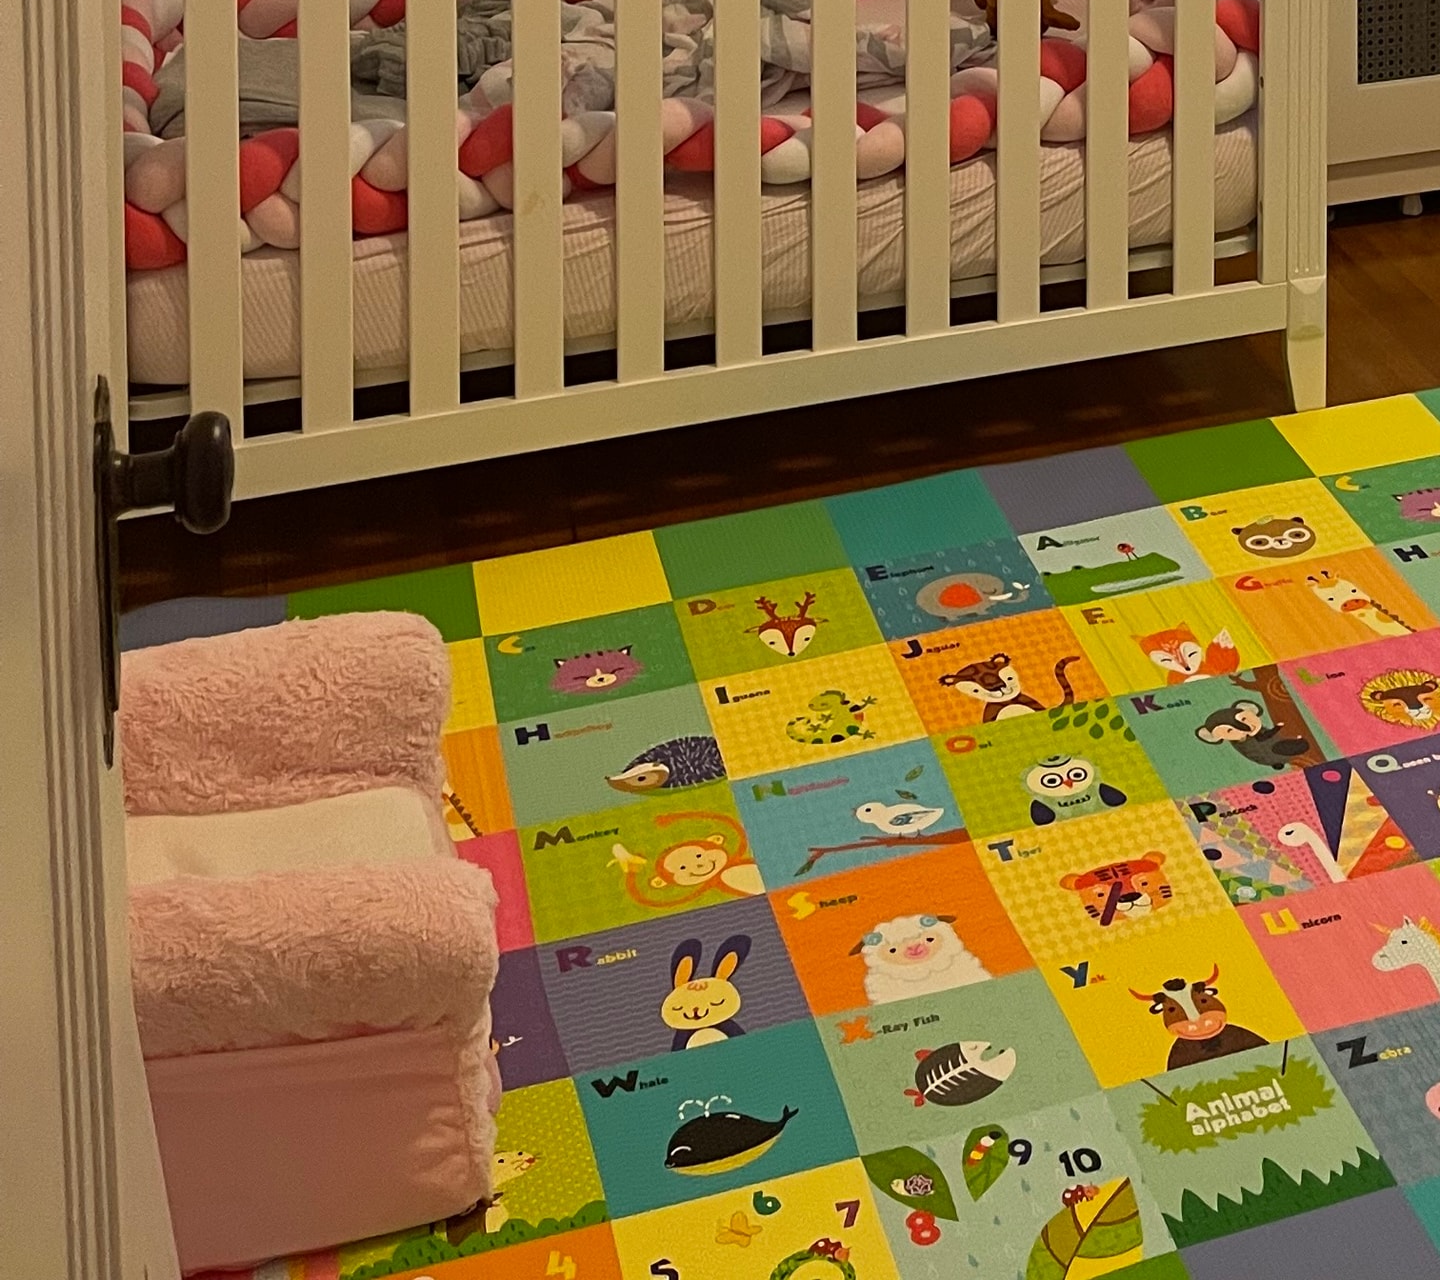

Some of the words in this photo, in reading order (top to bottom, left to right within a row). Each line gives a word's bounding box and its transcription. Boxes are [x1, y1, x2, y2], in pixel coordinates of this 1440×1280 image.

[533, 826, 619, 850] Monkey
[787, 891, 857, 919] Sheep
[1261, 907, 1341, 935] Unicorn
[556, 945, 636, 972] Rabbit
[836, 1016, 908, 1044] X-Ray
[912, 1013, 940, 1027] Fish
[1335, 1036, 1411, 1069] Zebra
[590, 1070, 668, 1098] Whale
[1185, 1077, 1283, 1122] Animal
[1191, 1096, 1291, 1136] alphabet
[1007, 1138, 1032, 1165] 9
[1058, 1147, 1102, 1177] 10
[753, 1190, 782, 1215] 6
[835, 1199, 861, 1227] 7
[905, 1210, 941, 1245] 8
[545, 1250, 577, 1280] 4
